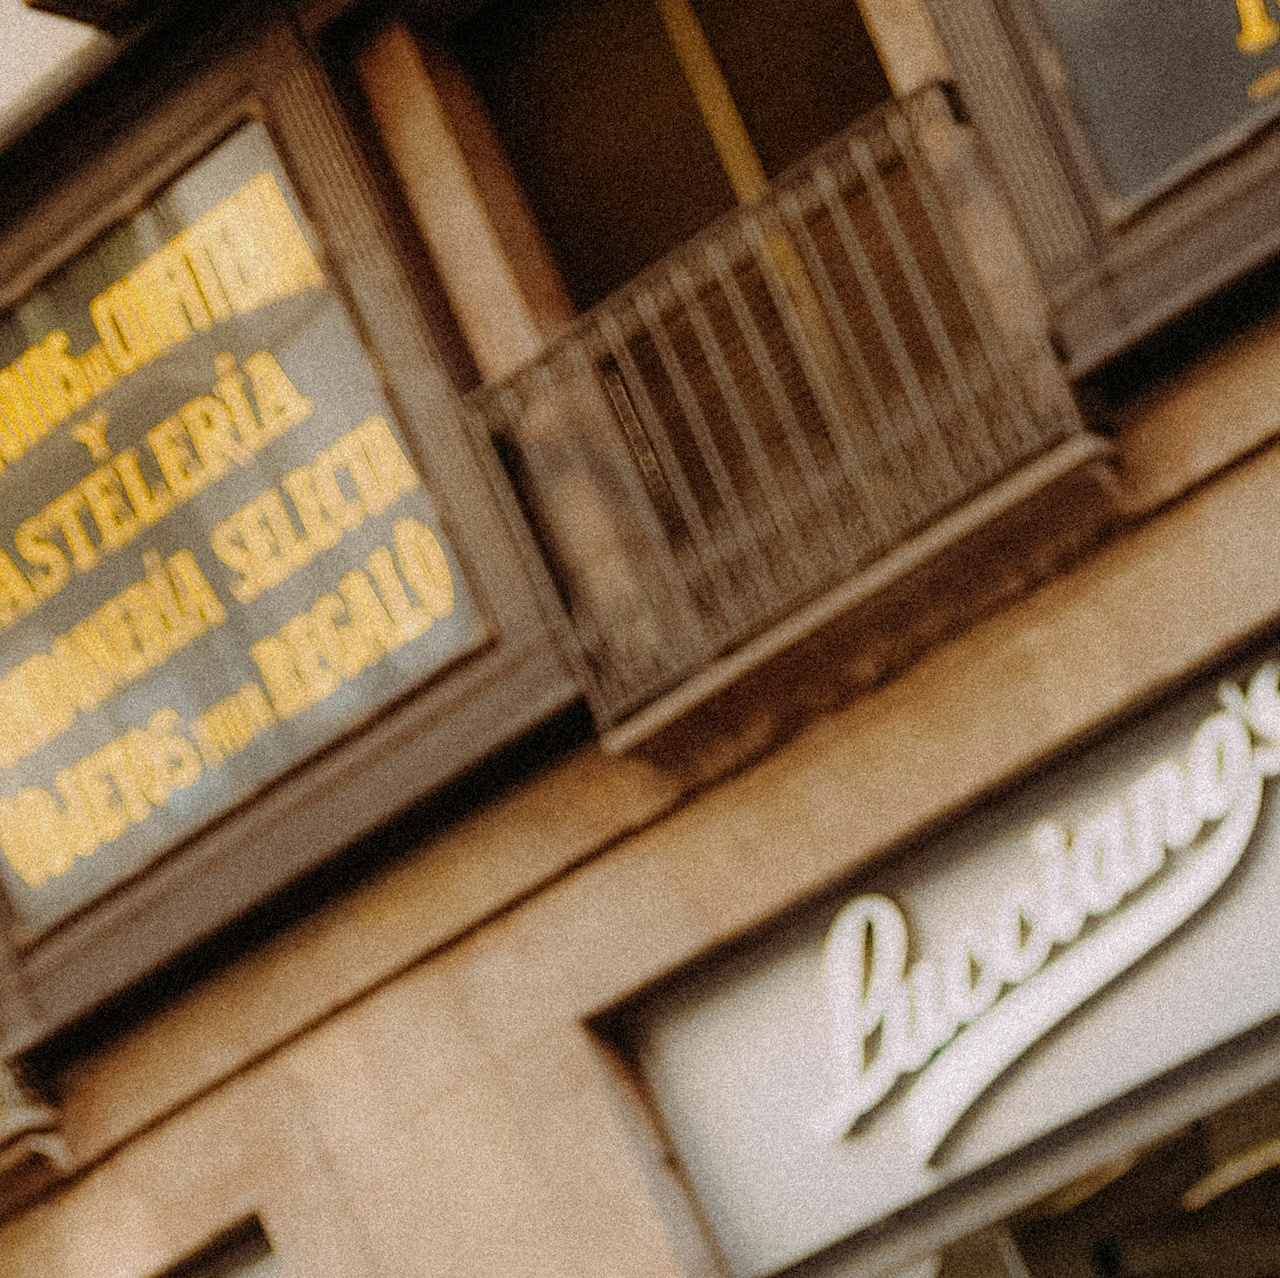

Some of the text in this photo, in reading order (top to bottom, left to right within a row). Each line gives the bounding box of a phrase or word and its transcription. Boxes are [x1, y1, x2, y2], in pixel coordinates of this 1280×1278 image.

[0, 350, 314, 628] ASTELERÍA
[71, 409, 109, 461] Y
[250, 517, 455, 722] REGALO
